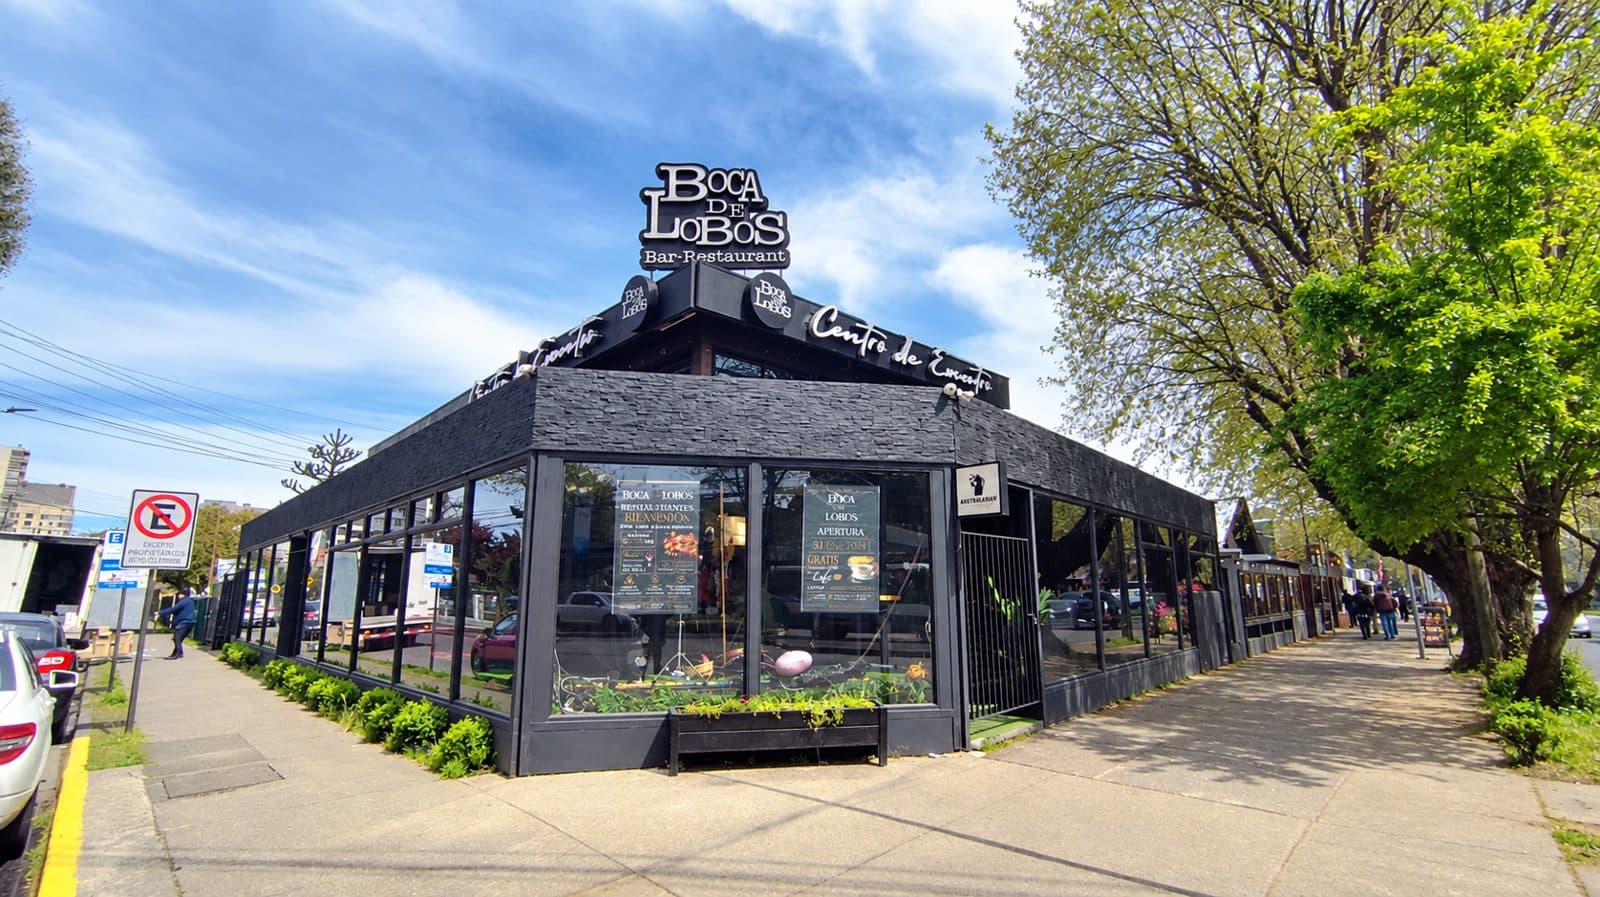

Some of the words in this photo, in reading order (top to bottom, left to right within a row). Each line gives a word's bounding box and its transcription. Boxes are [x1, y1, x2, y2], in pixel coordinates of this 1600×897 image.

[660, 165, 764, 202] BOCA
[706, 199, 745, 218] DE
[644, 250, 786, 264] Bar-Restaurant
[811, 305, 888, 357] Centro
[891, 336, 923, 366] de
[816, 527, 865, 536] APERTURA
[807, 554, 840, 566] GRATIS
